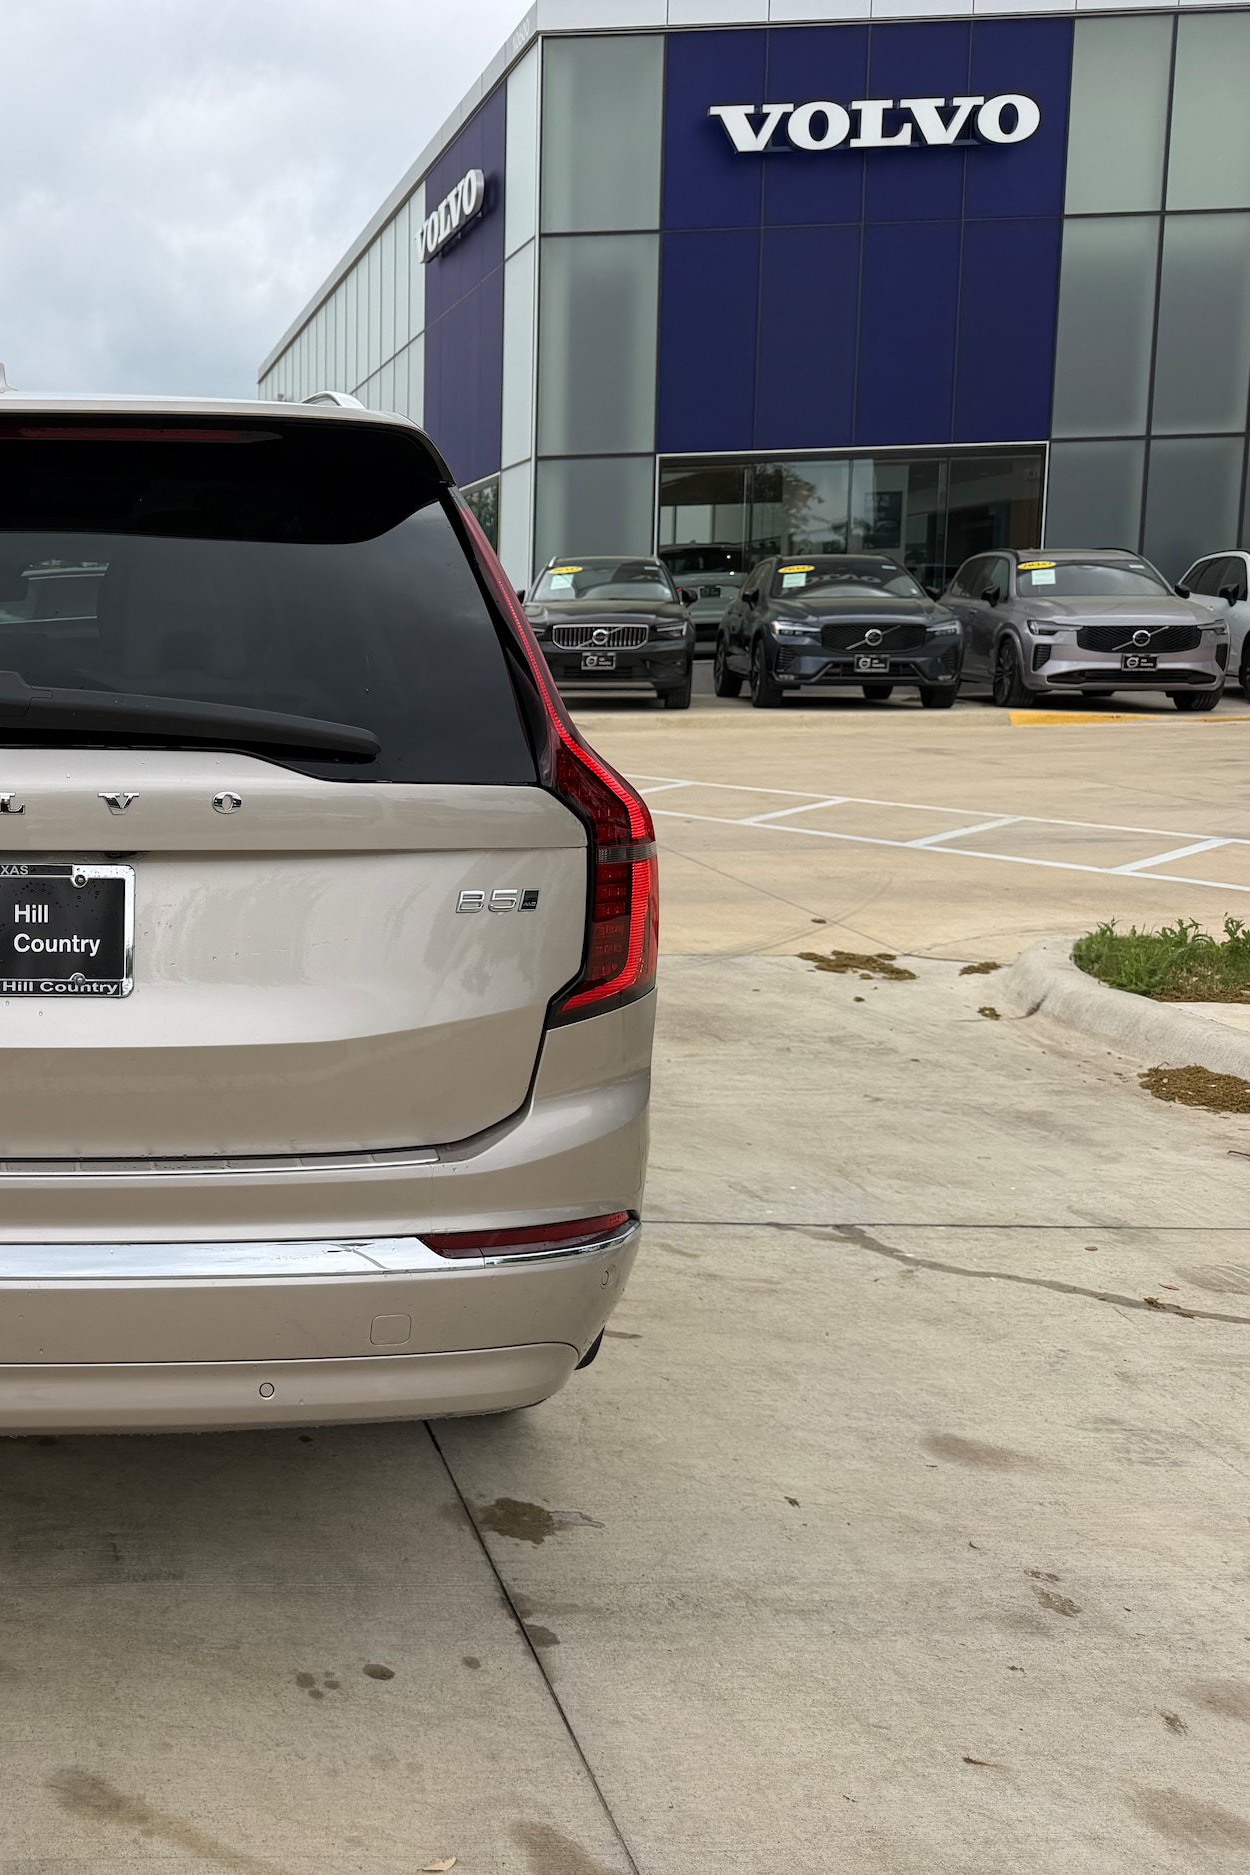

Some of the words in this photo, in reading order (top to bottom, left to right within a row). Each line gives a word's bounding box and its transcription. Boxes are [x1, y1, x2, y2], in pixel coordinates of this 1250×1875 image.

[708, 93, 1041, 153] VOLVO
[415, 169, 484, 264] VOLVO
[456, 889, 518, 913] B5
[14, 904, 49, 923] Hill
[13, 933, 100, 957] Country
[2, 981, 34, 992] Hill
[40, 982, 118, 995] Country
